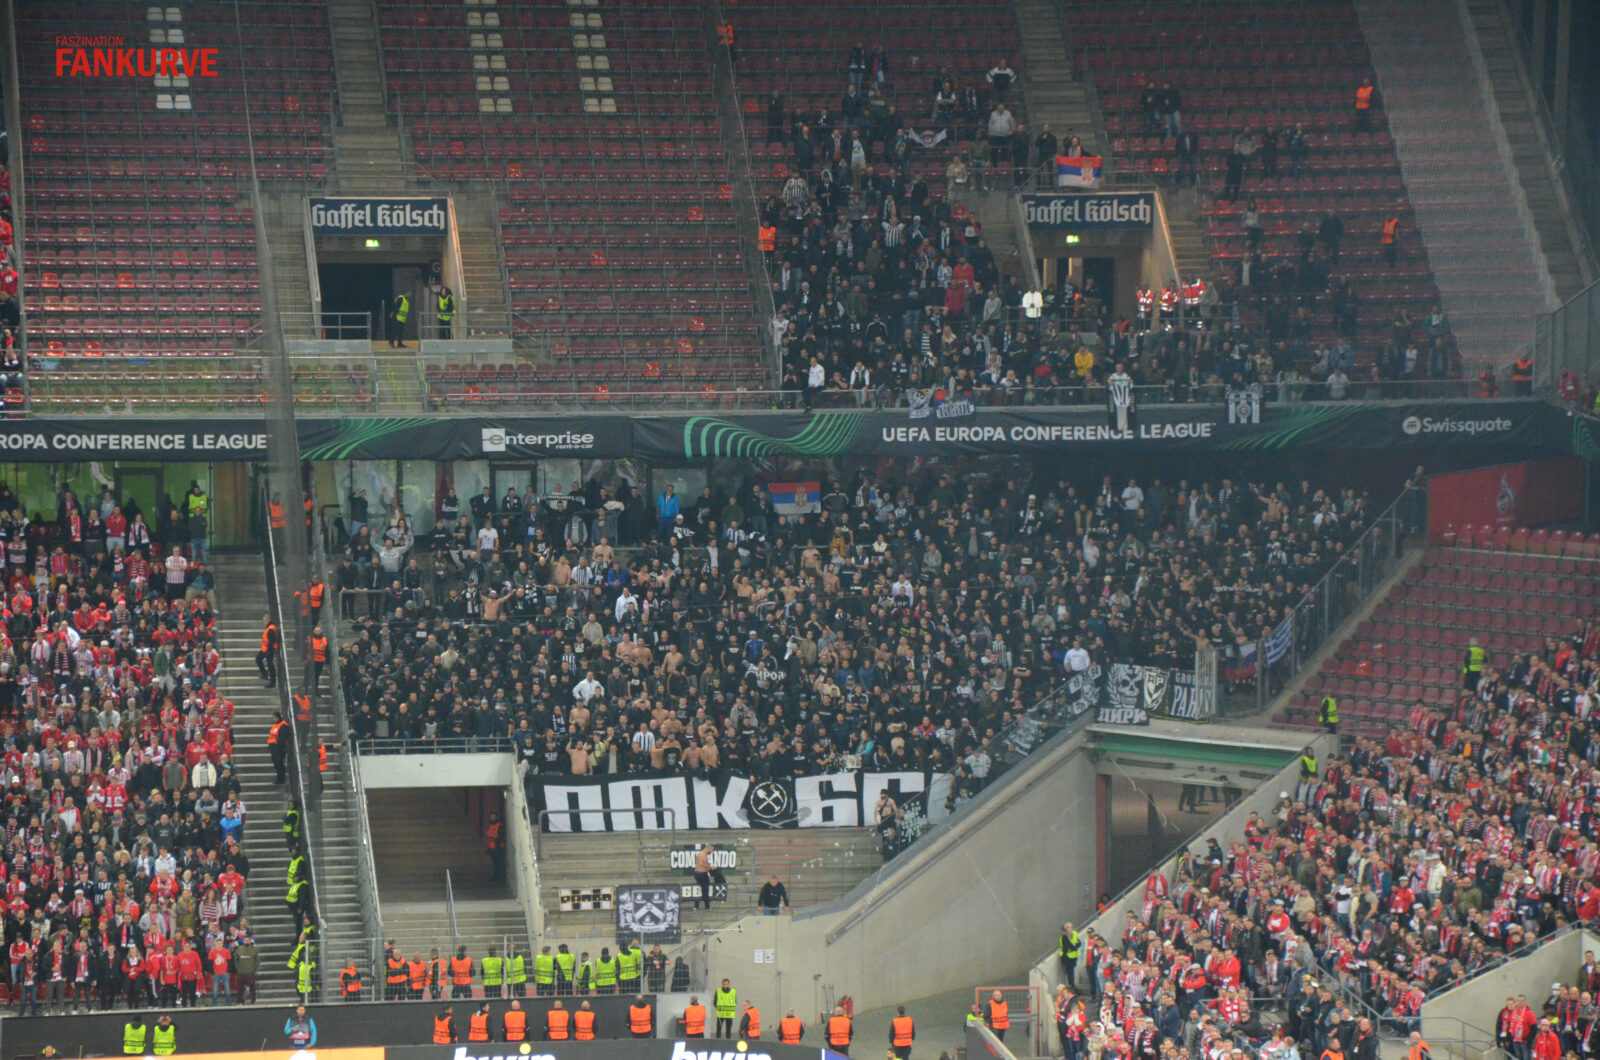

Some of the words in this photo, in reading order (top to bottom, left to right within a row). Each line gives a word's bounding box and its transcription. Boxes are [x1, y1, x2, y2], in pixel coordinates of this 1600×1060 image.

[312, 203, 374, 229] Gaffel
[377, 203, 445, 230] Kölsch
[1024, 199, 1082, 224] Gaffel
[1085, 198, 1151, 224] Kölsch
[882, 427, 930, 442] UEFA
[935, 427, 1006, 441] EUROPA
[1140, 422, 1211, 438] LEAGUE
[1422, 417, 1512, 435] Swissquote
[53, 434, 186, 449] CONFERENCE
[192, 434, 268, 449] LEAGUE
[482, 430, 594, 450] enterprise
[670, 850, 737, 868] COMANDO
